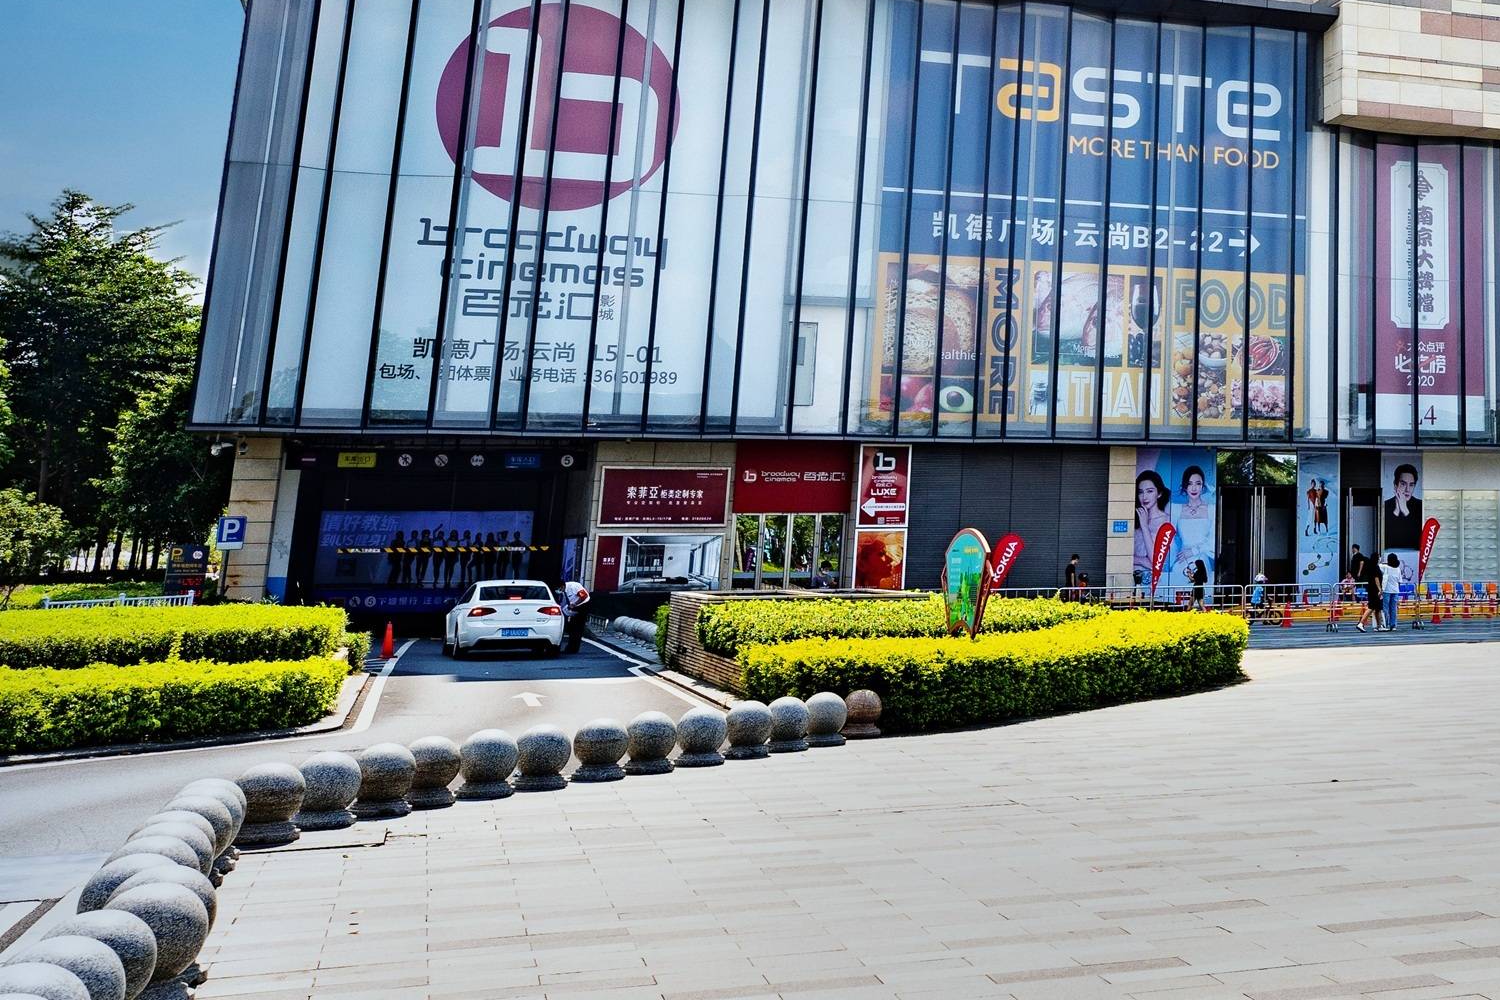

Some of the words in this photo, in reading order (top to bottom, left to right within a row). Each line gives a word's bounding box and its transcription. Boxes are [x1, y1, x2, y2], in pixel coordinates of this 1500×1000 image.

[1213, 147, 1281, 170] FOOD
[1174, 278, 1289, 330] FOOD
[870, 488, 897, 496] LUXE
[222, 520, 240, 541] P
[1155, 530, 1172, 570] KOKUA
[1422, 524, 1436, 563] KOKUA
[993, 541, 1018, 583] KOKUA
